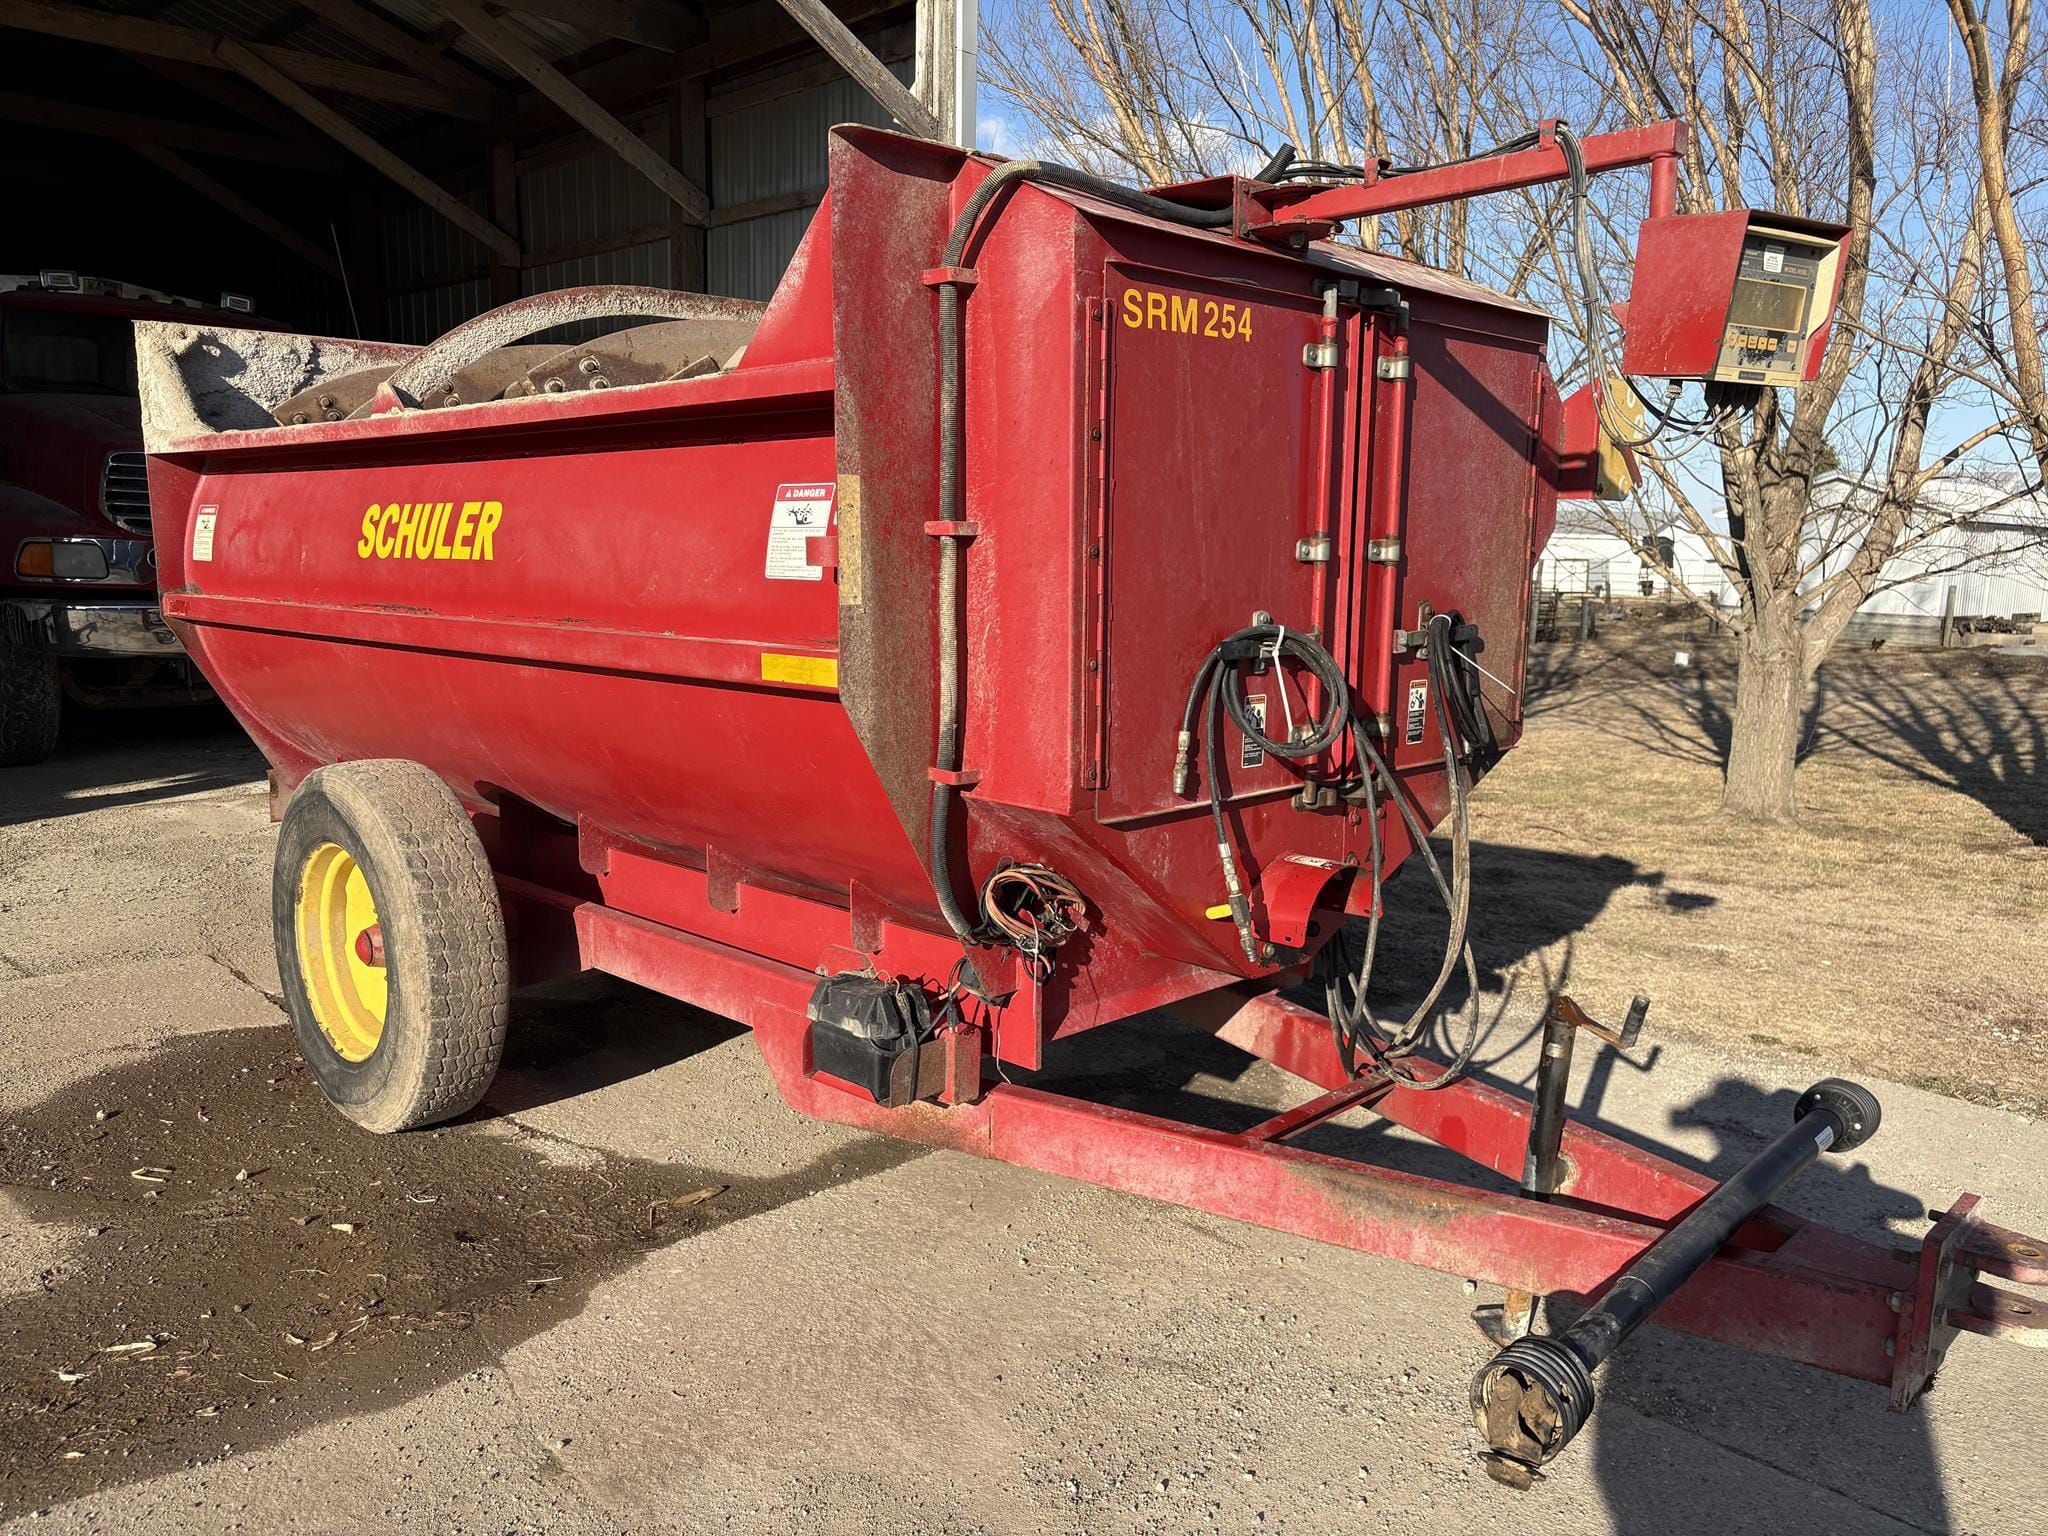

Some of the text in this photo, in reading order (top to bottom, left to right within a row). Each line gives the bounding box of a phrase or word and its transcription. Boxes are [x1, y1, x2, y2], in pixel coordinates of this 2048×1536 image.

[1123, 288, 1253, 342] SRM 254
[793, 489, 826, 498] DANGER
[357, 501, 503, 561] SCHULER
